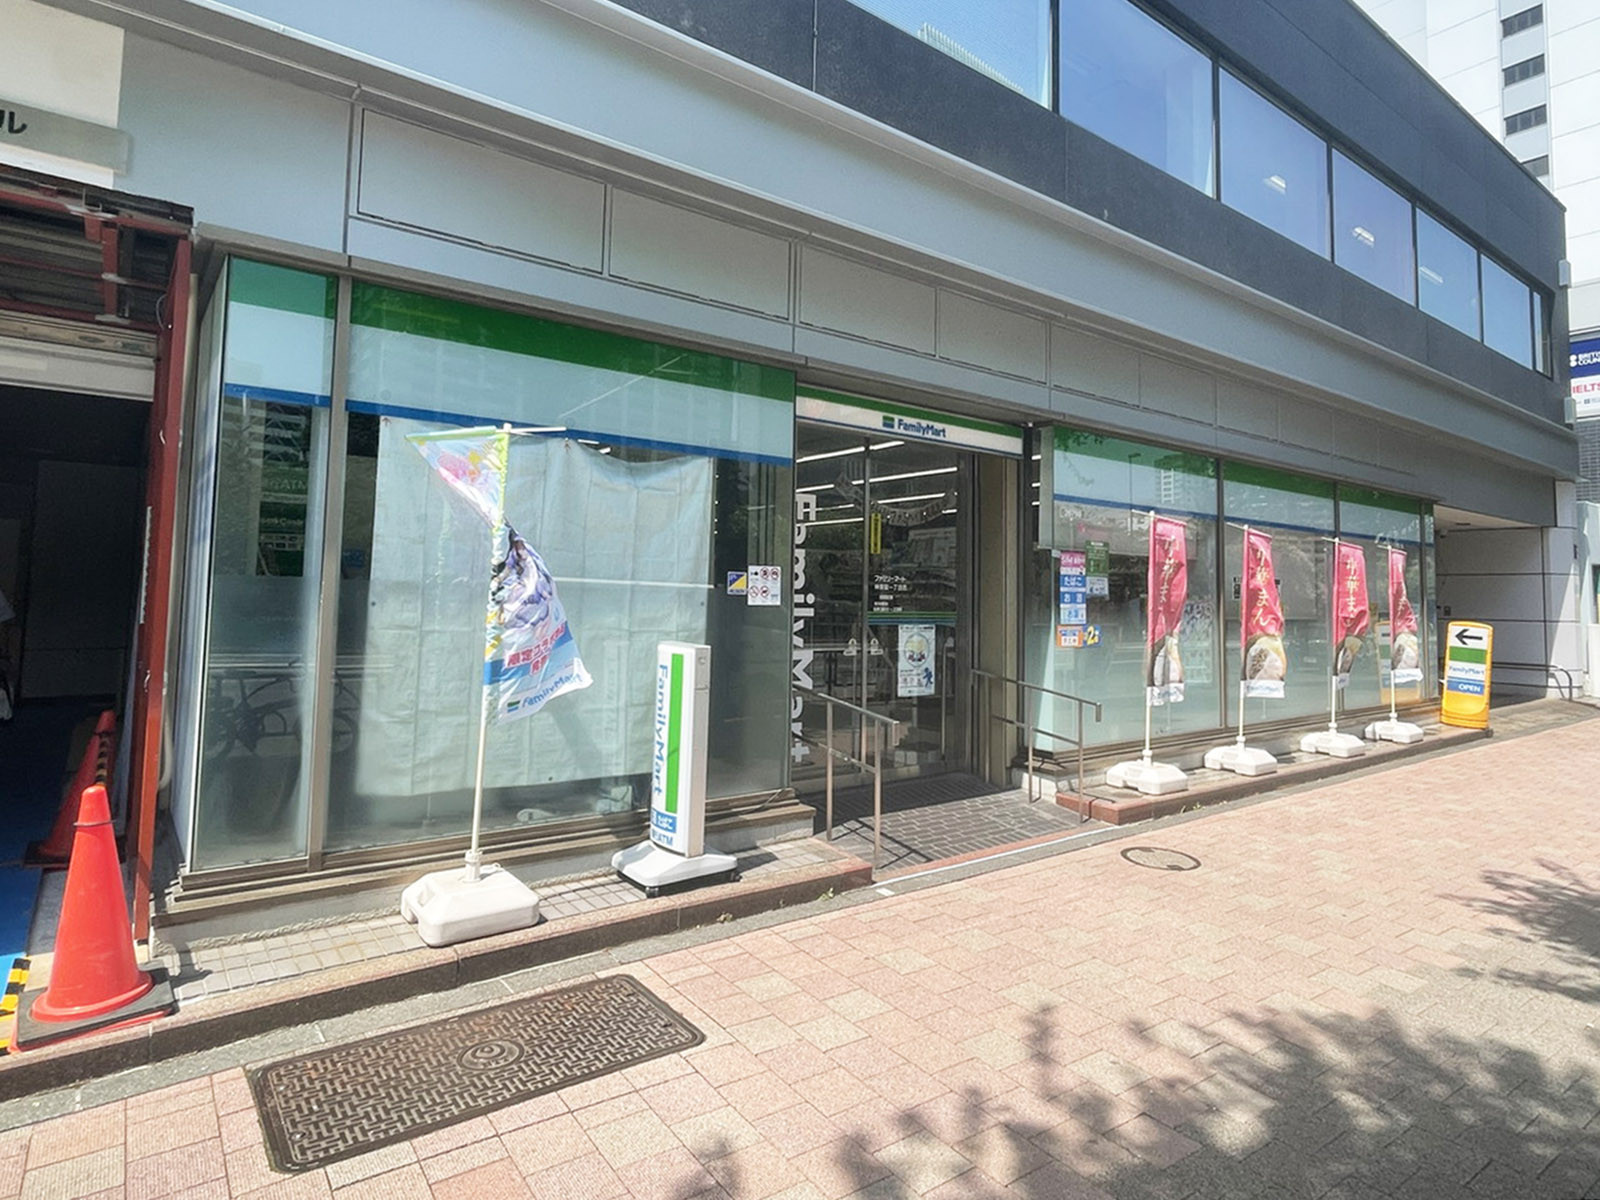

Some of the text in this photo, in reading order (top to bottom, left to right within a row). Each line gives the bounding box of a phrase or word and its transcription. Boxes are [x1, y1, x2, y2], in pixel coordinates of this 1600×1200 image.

[898, 418, 946, 438] FamilyMart
[1449, 665, 1485, 675] FamilyMart
[522, 673, 583, 708] FamilyMart
[1458, 683, 1481, 692] OPEN
[654, 664, 668, 796] FamilyMart
